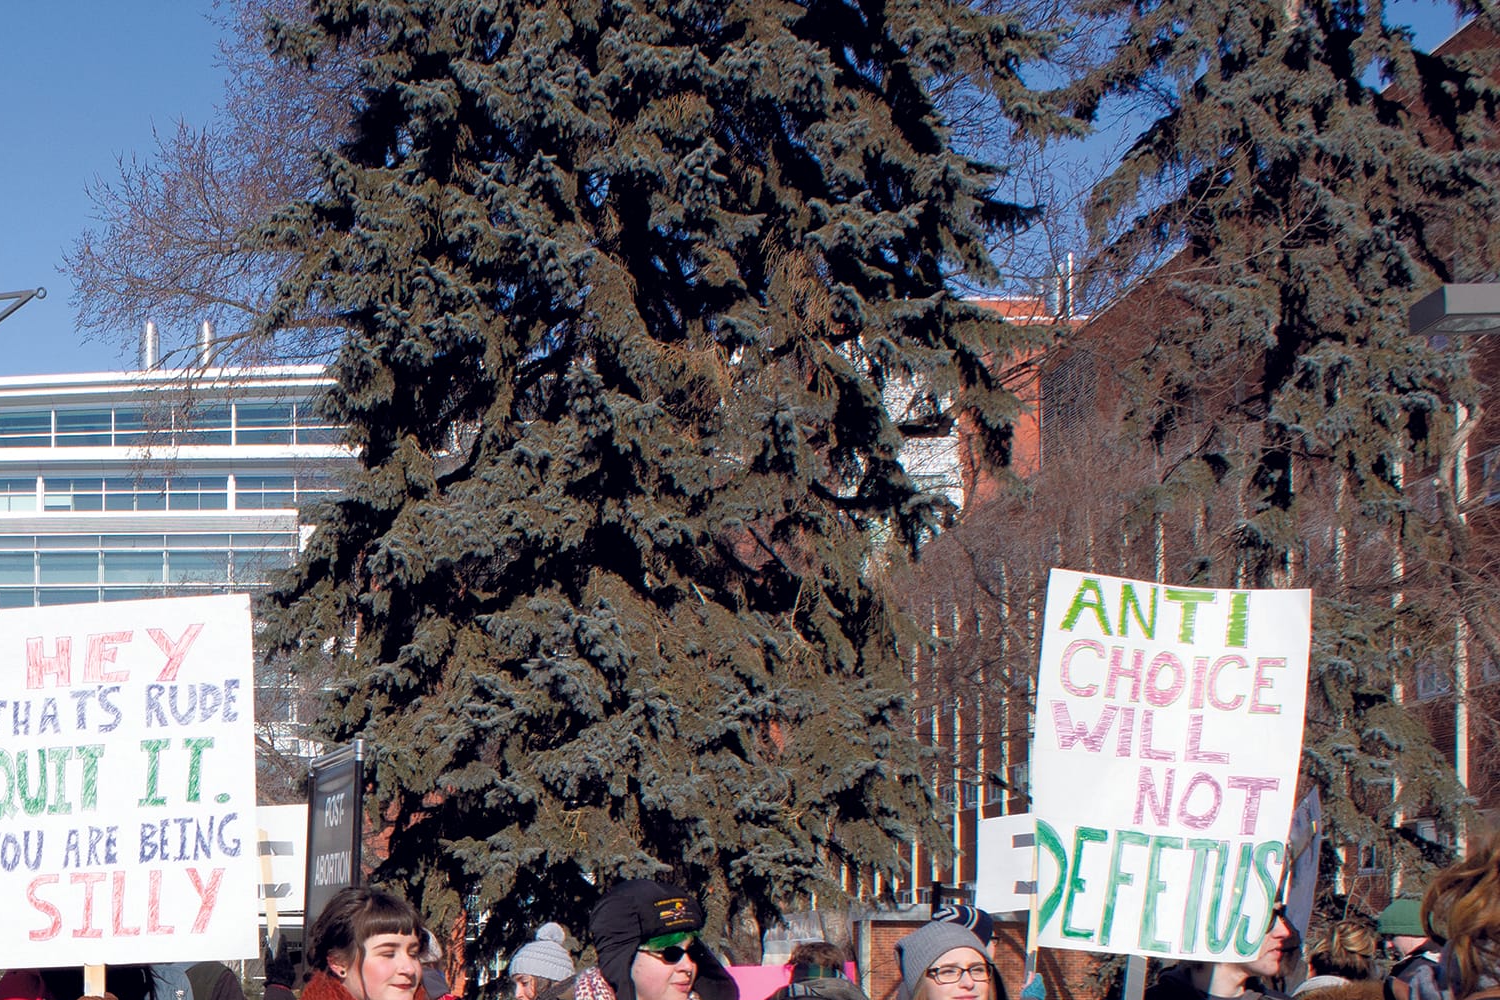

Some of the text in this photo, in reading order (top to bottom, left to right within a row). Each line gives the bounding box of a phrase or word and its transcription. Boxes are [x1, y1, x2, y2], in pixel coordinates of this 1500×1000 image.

[1059, 577, 1251, 649] ANTI
[25, 622, 205, 690] HEY
[1059, 638, 1287, 715] CHOICE
[145, 678, 241, 728] RUDE
[1049, 699, 1230, 765] WILL
[137, 736, 232, 808] IT.
[1131, 765, 1281, 836] NOT
[62, 825, 119, 870] ARE
[138, 812, 242, 864] BEING
[314, 850, 350, 886] ABORTION
[28, 867, 226, 942] SILLY
